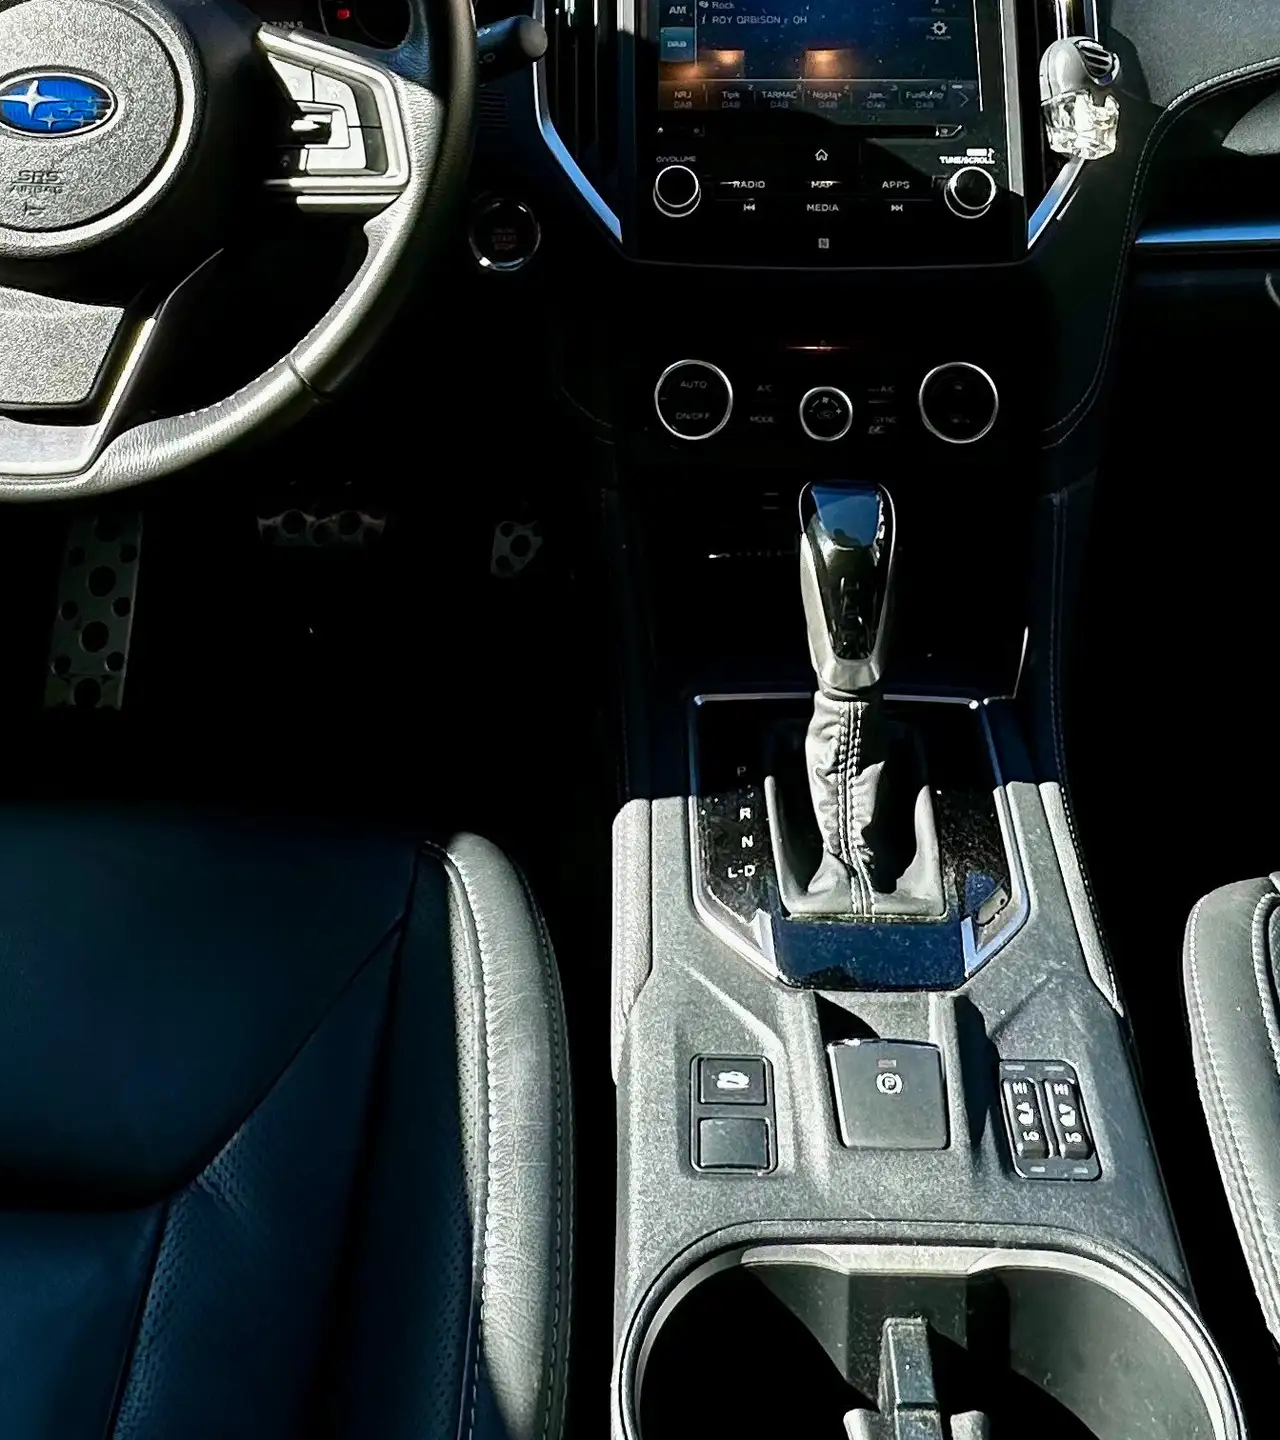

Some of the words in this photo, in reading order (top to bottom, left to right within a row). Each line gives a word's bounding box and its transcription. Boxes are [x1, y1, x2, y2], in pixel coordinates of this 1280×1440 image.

[712, 1, 735, 9] Rock
[669, 6, 687, 14] AM
[712, 16, 733, 24] ROY
[736, 15, 781, 25] ORBISON
[762, 91, 798, 99] TARMAC
[733, 181, 766, 189] RADIO
[882, 181, 910, 189] APPS
[806, 204, 839, 212] MEDIA
[680, 380, 708, 389] AUTO
[737, 766, 747, 777] P
[740, 807, 751, 820] R
[741, 835, 754, 848] N
[1012, 1082, 1028, 1095] HI
[1053, 1083, 1069, 1096] HI
